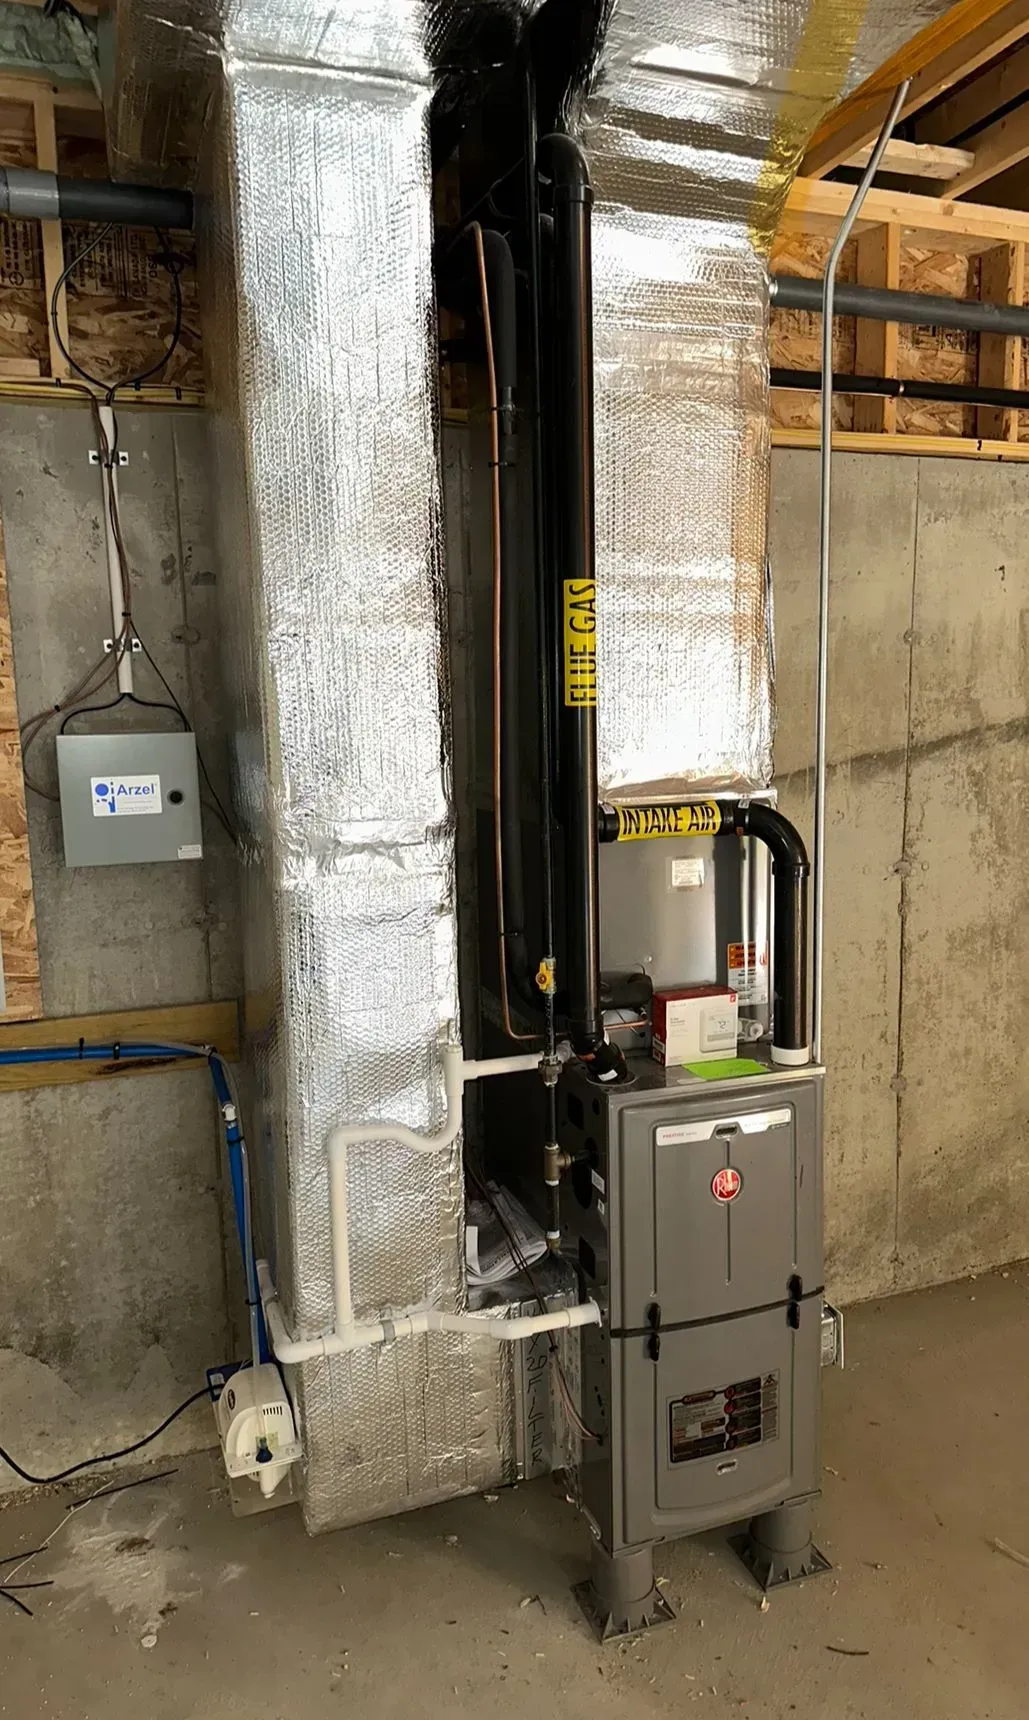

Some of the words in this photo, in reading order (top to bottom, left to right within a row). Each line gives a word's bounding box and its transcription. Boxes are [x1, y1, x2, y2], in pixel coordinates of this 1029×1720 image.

[568, 583, 597, 634] GAS
[569, 644, 597, 702] FLUE
[116, 783, 155, 796] Arzel
[621, 806, 684, 835] INTAKE
[687, 806, 717, 833] AIR
[527, 1372, 544, 1467] FILTER
